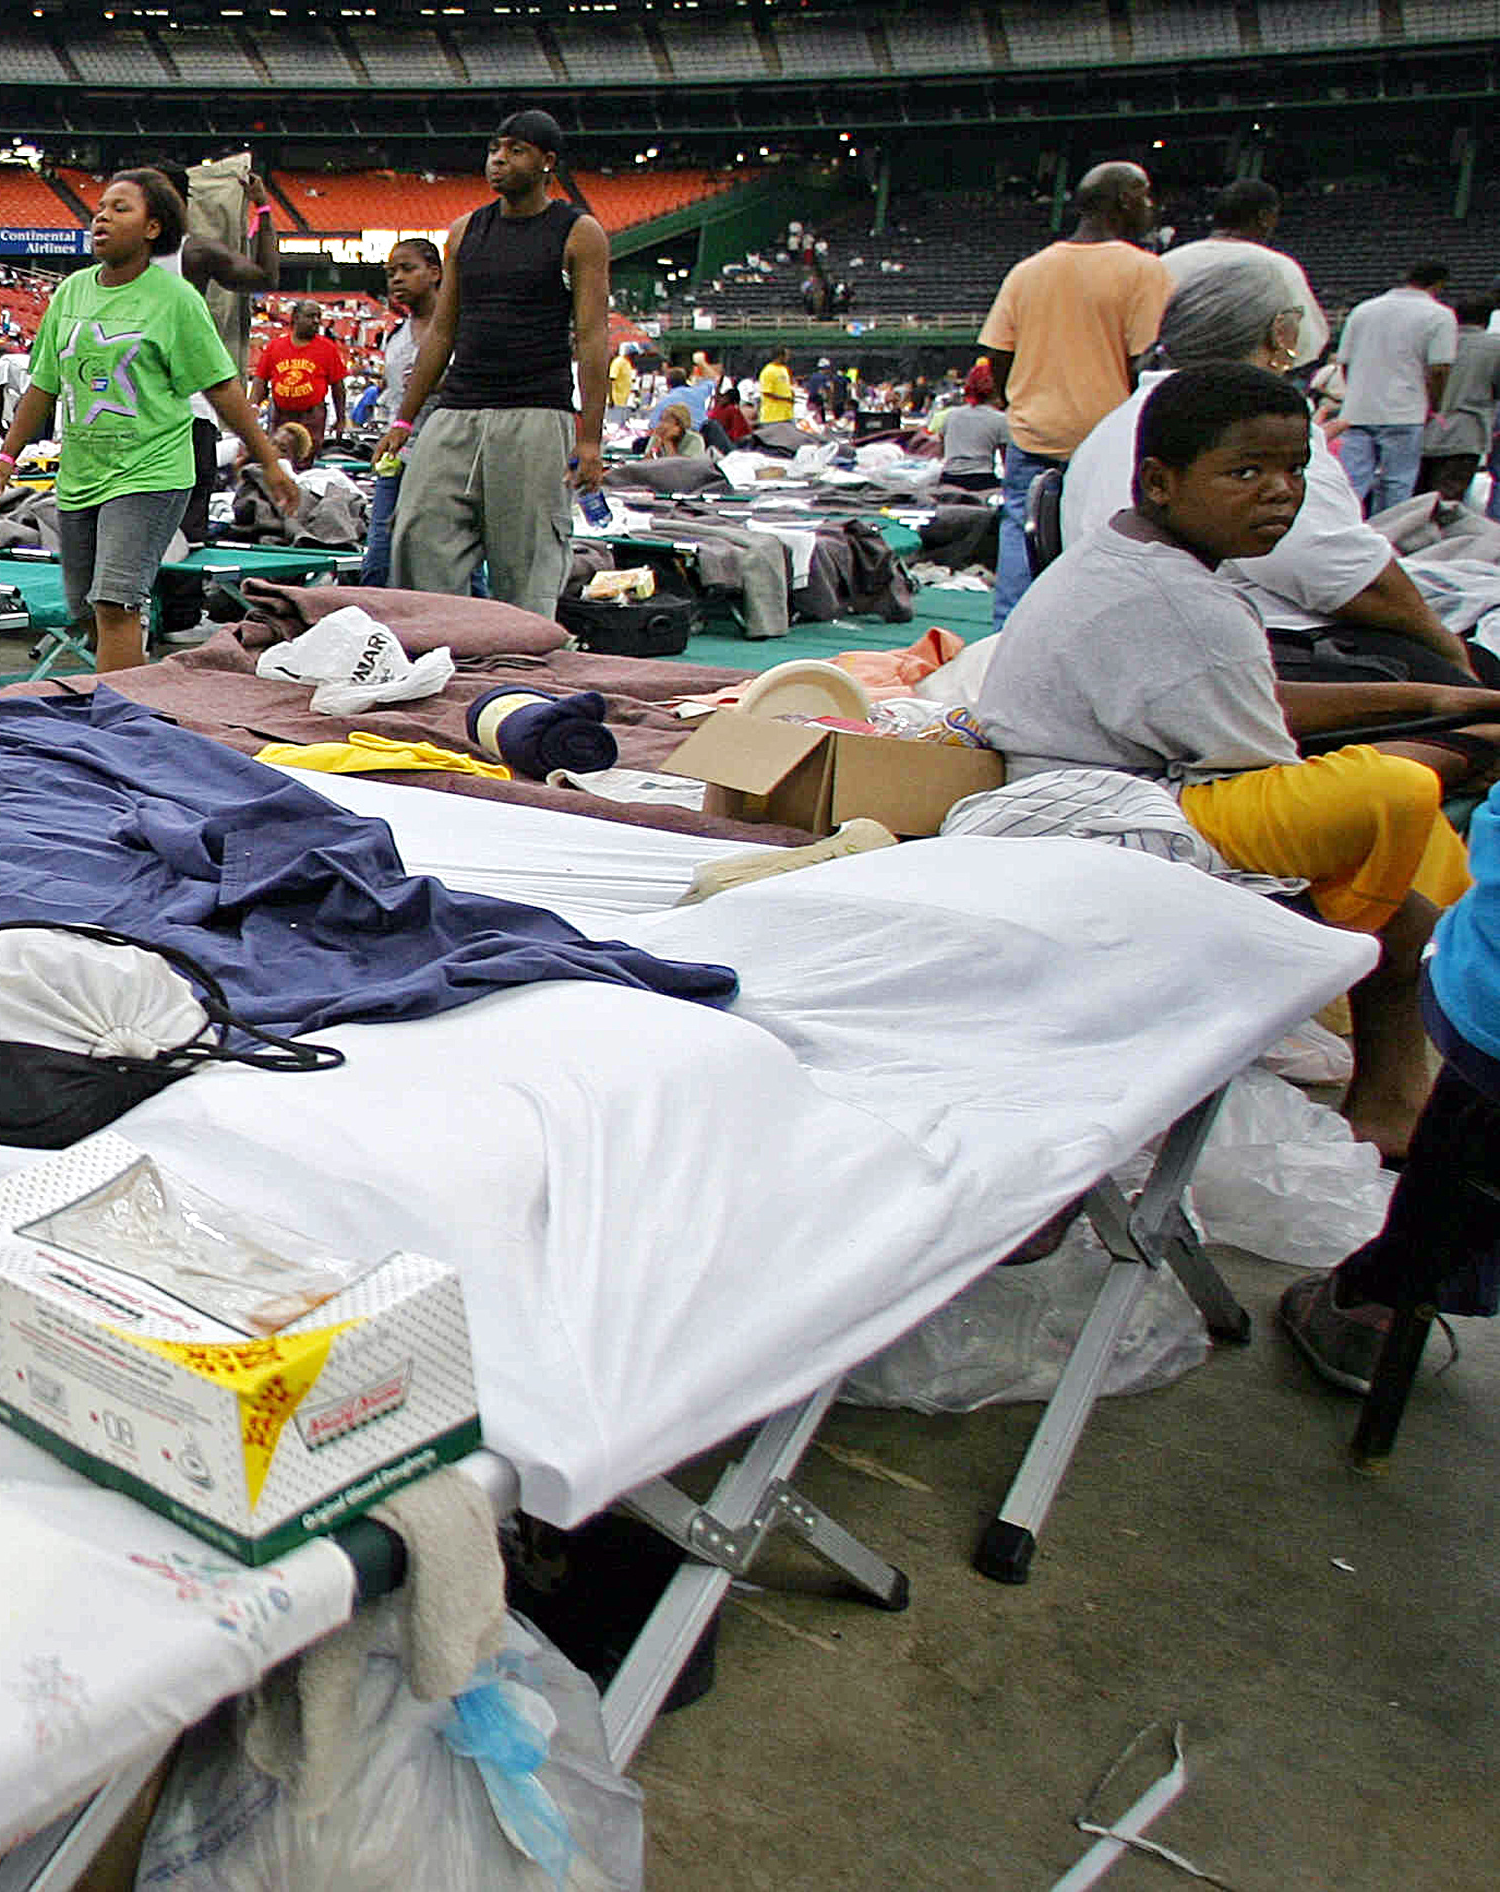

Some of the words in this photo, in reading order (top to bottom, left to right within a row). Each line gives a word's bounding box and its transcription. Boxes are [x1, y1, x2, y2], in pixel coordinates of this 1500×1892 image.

[0, 229, 76, 241] Continental
[25, 242, 77, 254] Airlines
[302, 1494, 348, 1529] Original
